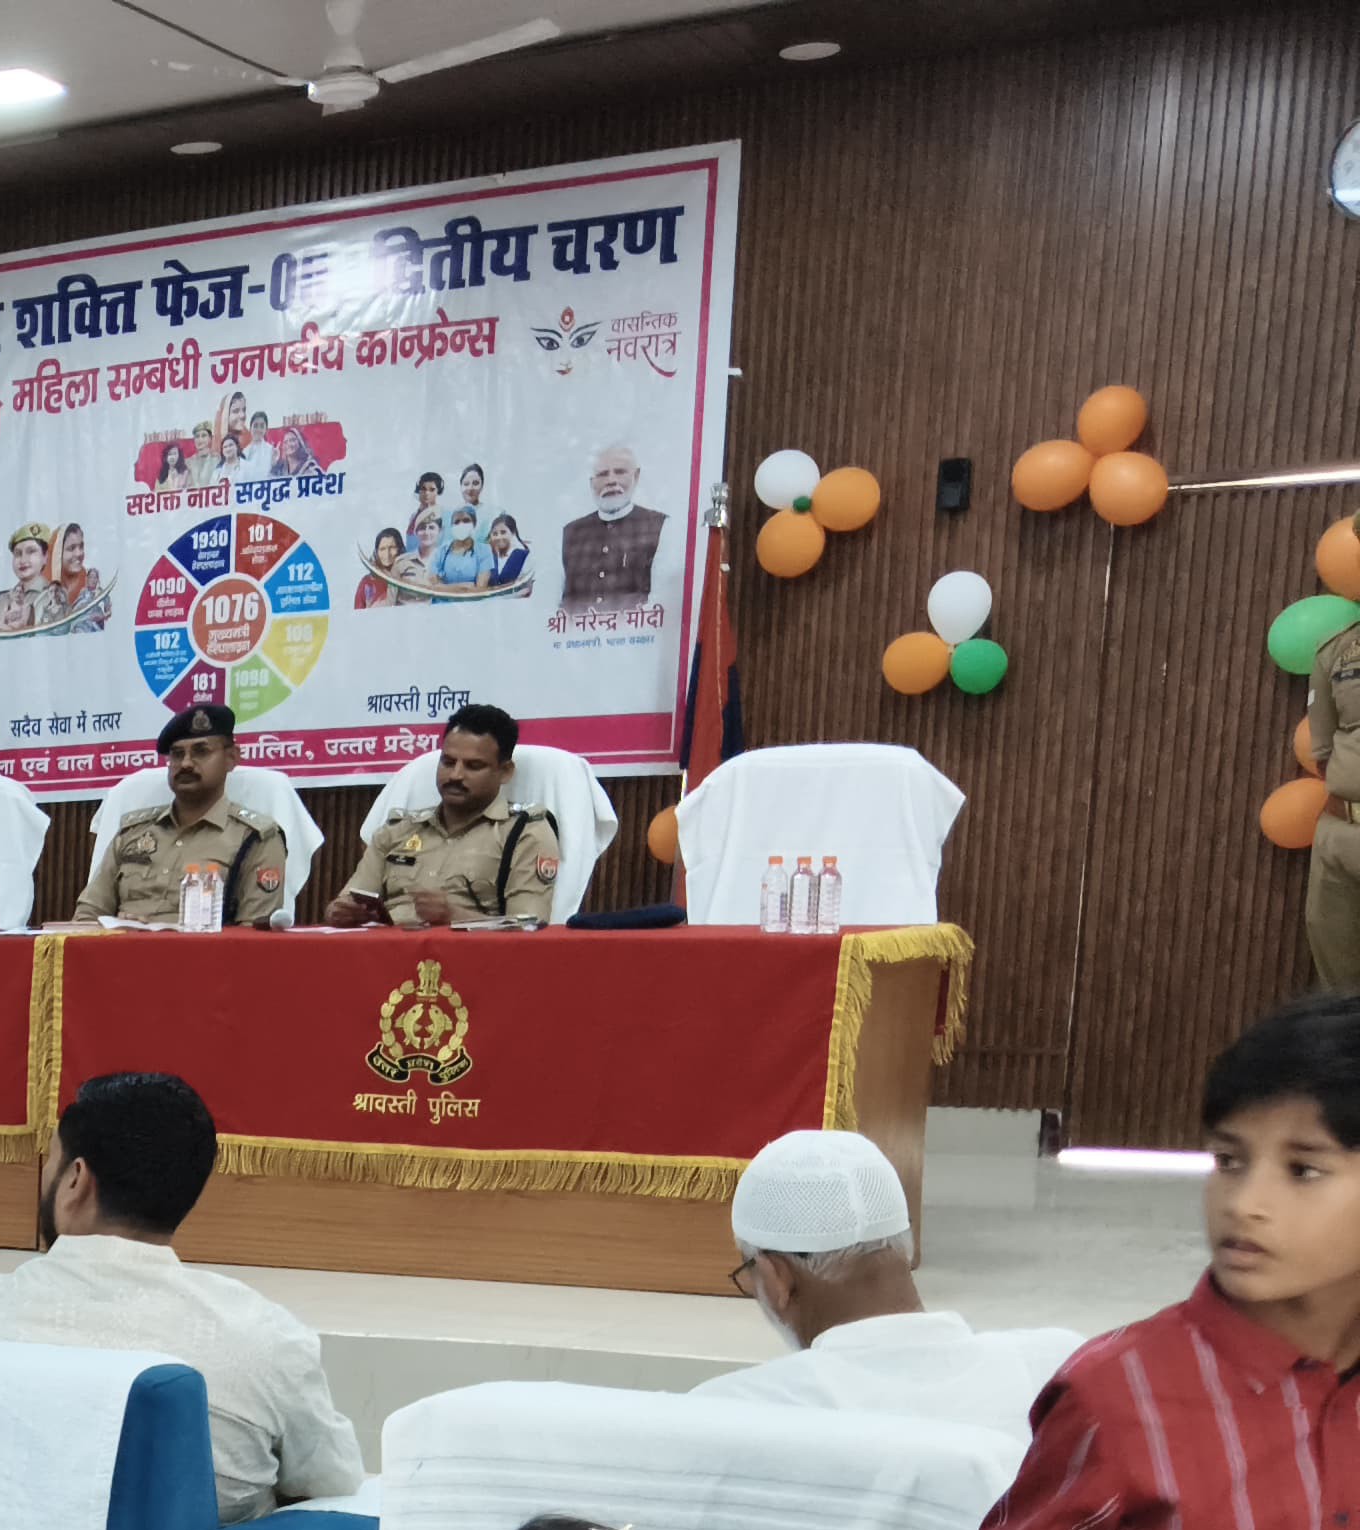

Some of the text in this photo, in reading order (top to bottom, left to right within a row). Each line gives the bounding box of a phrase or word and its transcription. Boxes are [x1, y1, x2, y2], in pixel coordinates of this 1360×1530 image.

[13, 273, 143, 348] शक्ति
[547, 205, 685, 275] चरण
[610, 310, 679, 334] वासन्तिक
[605, 331, 682, 377] नवरात्र
[12, 358, 99, 413] महिला
[106, 337, 202, 402] सम्बंधी
[126, 472, 346, 516] सशक्त नारी समृद्ध प्रदेश
[191, 523, 273, 550] 1930 101
[148, 577, 186, 596] 1090
[287, 562, 315, 581] 112
[202, 592, 259, 625] 1076
[547, 603, 665, 634] श्री नरेन्द्र मोदी
[153, 632, 180, 650] 102
[191, 672, 217, 691] 181
[367, 685, 471, 718] श्रावस्ती पुलिस
[9, 709, 123, 738] सदैव सेवा में तत्पर
[324, 735, 378, 756] उत्तर
[383, 727, 440, 754] प्रदेश
[20, 750, 50, 777] एवं
[57, 752, 94, 772] बाल
[100, 744, 159, 771] संगठन
[352, 1088, 481, 1125] श्रावस्ती पुलिस
